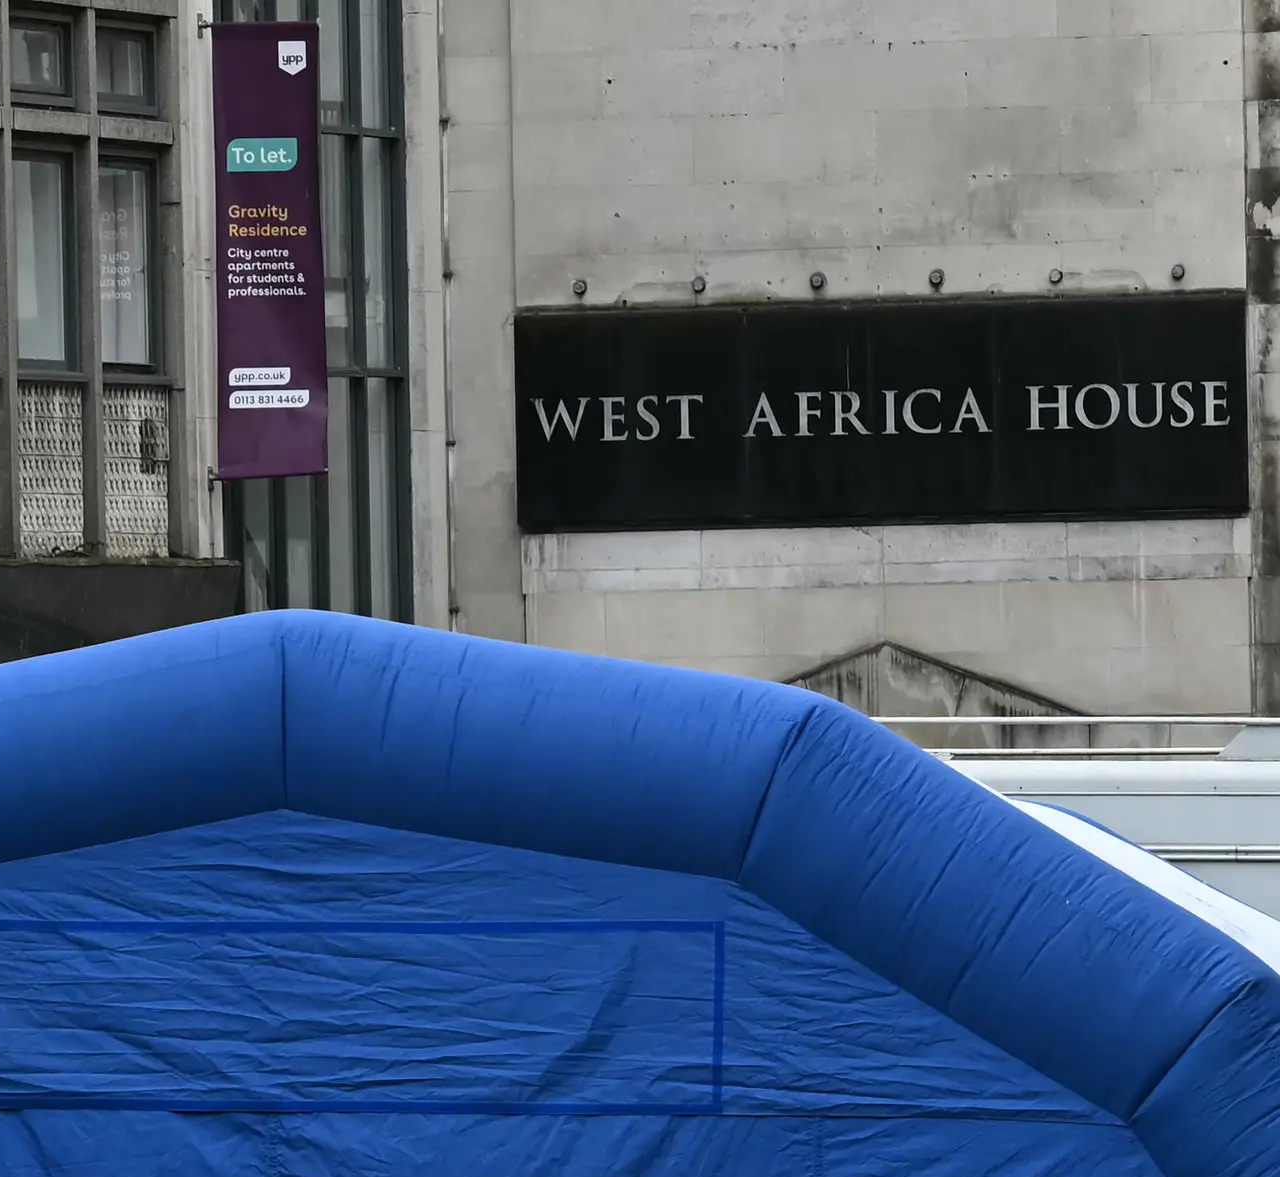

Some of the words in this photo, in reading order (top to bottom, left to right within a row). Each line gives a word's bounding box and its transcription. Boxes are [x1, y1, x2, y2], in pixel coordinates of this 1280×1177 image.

[282, 55, 303, 66] ypp
[231, 147, 255, 164] To
[260, 146, 292, 164] let.
[228, 203, 288, 222] Gravity
[228, 223, 308, 238] Residence
[227, 248, 252, 261] City
[253, 249, 289, 258] centre
[227, 260, 296, 273] apartments
[227, 274, 245, 284] for
[246, 273, 295, 284] students
[296, 272, 305, 283] &
[228, 285, 307, 299] professionals.
[234, 371, 286, 383] ypp.co.uk
[234, 395, 255, 405] 0113
[258, 395, 274, 404] 831
[277, 394, 305, 404] 4466
[530, 394, 704, 443] WEST
[742, 386, 993, 438] AFRICA
[1025, 380, 1231, 432] HOUSE
